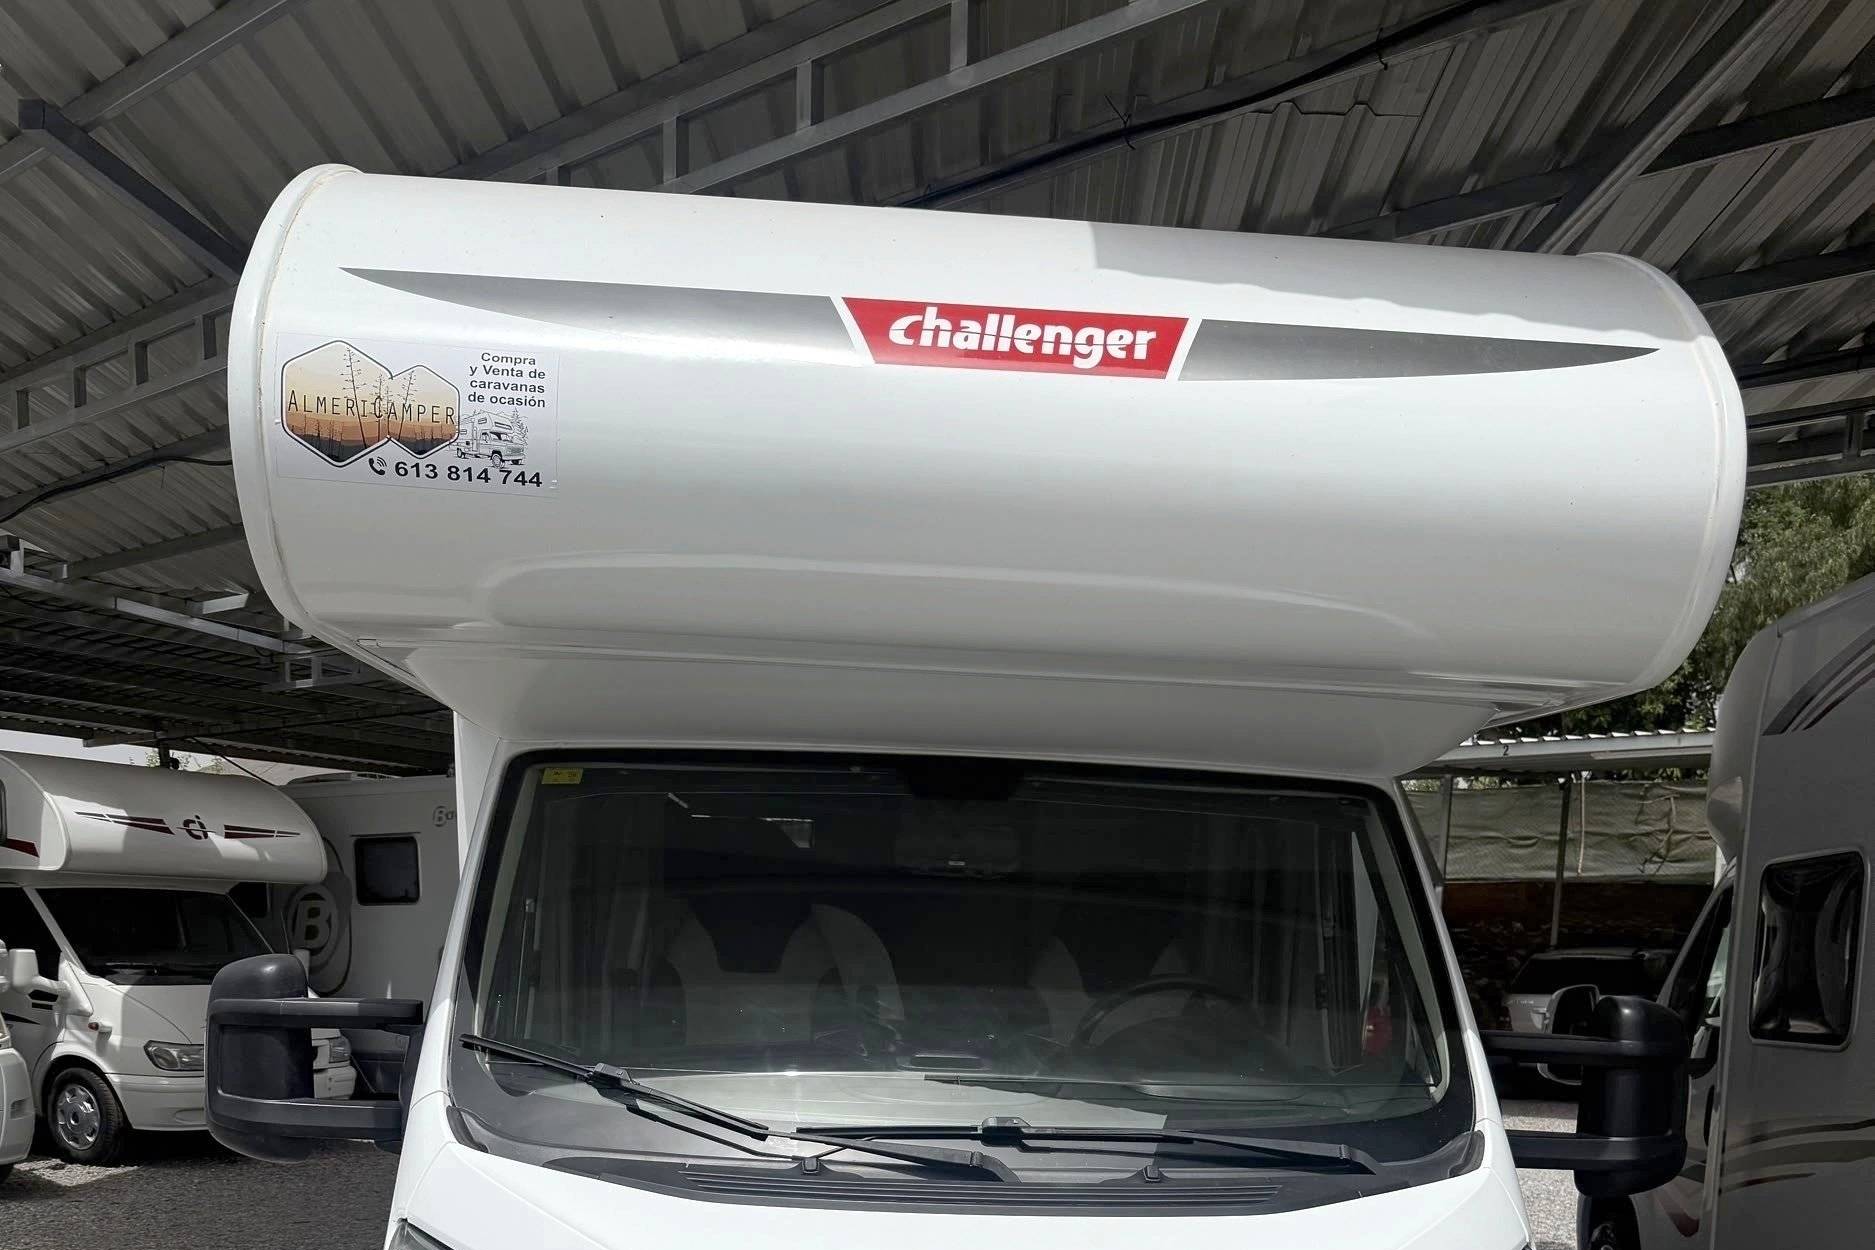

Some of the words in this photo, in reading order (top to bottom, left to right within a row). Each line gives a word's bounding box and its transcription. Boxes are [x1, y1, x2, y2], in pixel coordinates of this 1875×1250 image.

[888, 306, 1157, 369] challenger
[481, 352, 536, 366] Compra
[469, 365, 477, 376] y
[482, 365, 524, 378] Venta
[528, 368, 546, 380] de
[469, 379, 545, 393] caravanas
[468, 391, 485, 403] de
[490, 393, 546, 408] ocasión
[395, 461, 438, 479] 613
[447, 465, 491, 484] 814
[501, 469, 543, 488] 744
